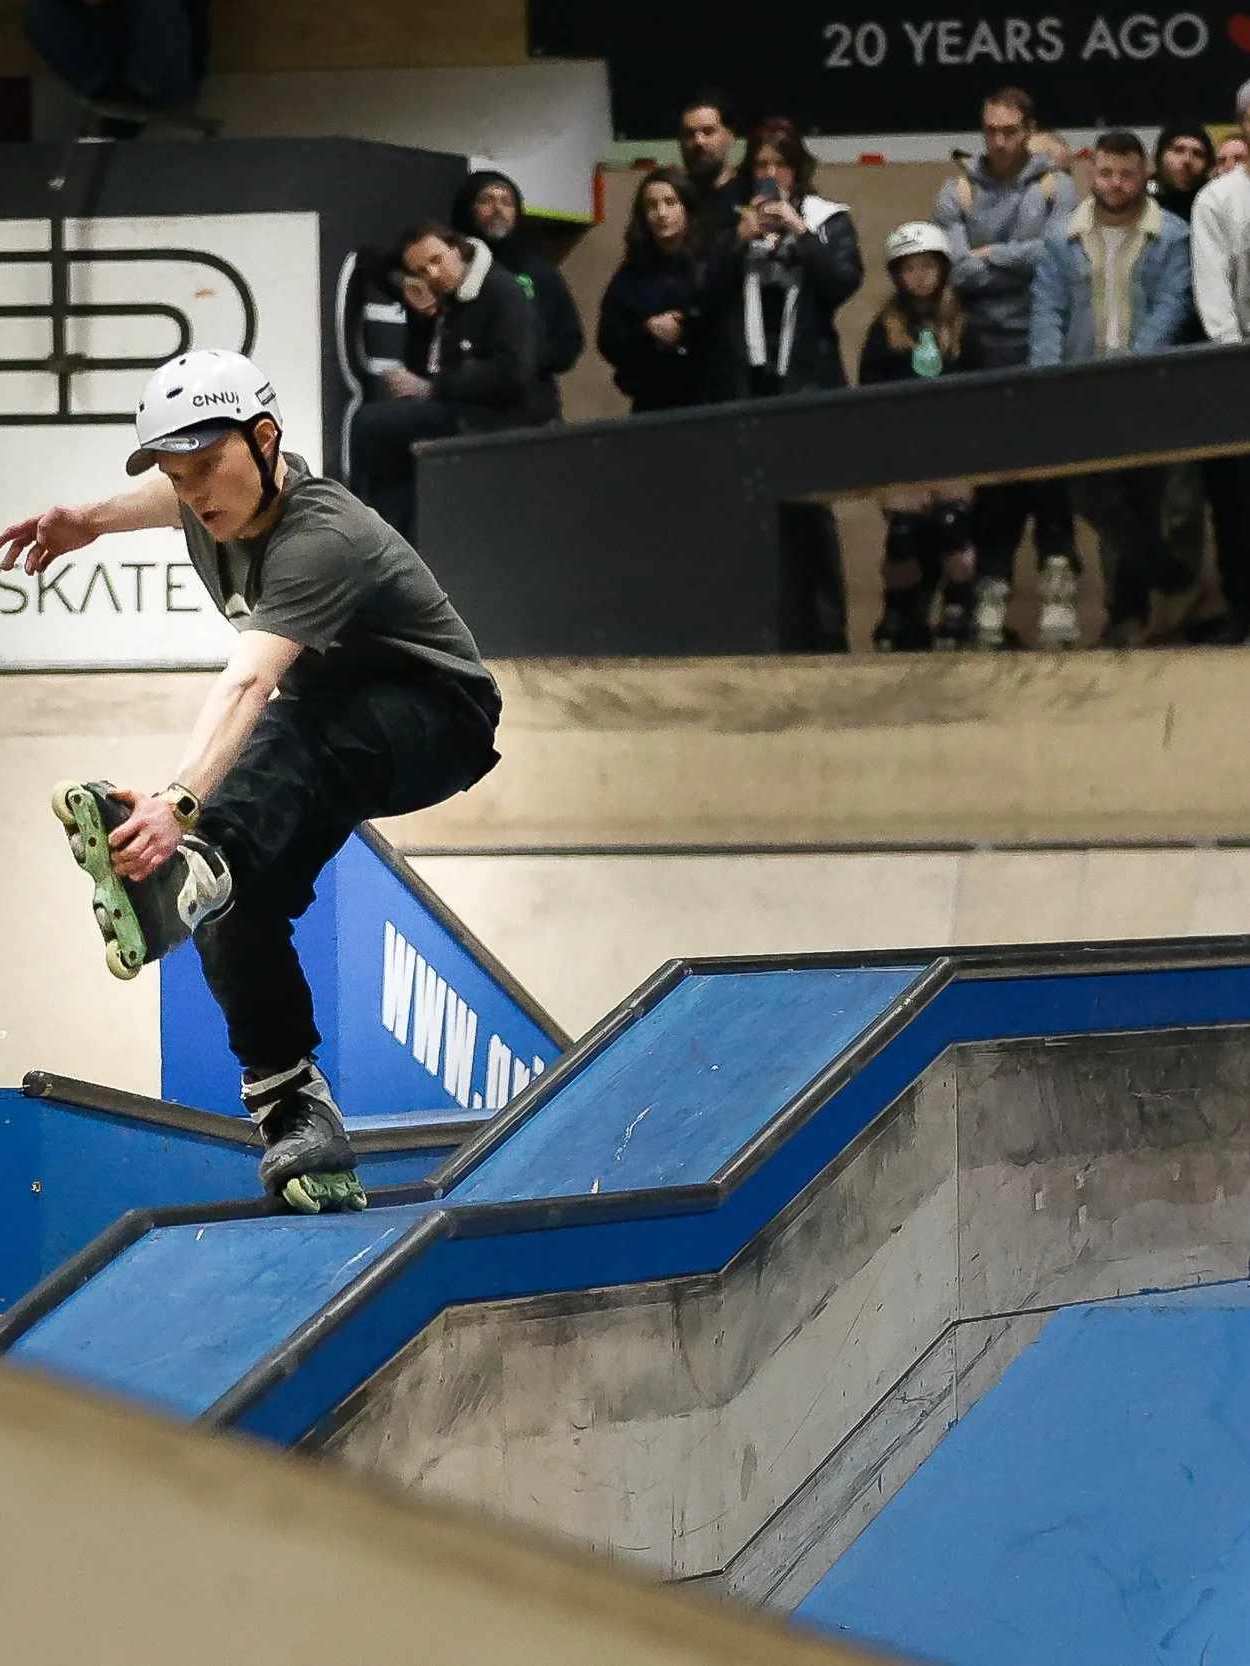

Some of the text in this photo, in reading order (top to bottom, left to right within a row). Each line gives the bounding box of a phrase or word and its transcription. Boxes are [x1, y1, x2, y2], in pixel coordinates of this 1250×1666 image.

[822, 11, 1209, 67] 20 YEARS AGO
